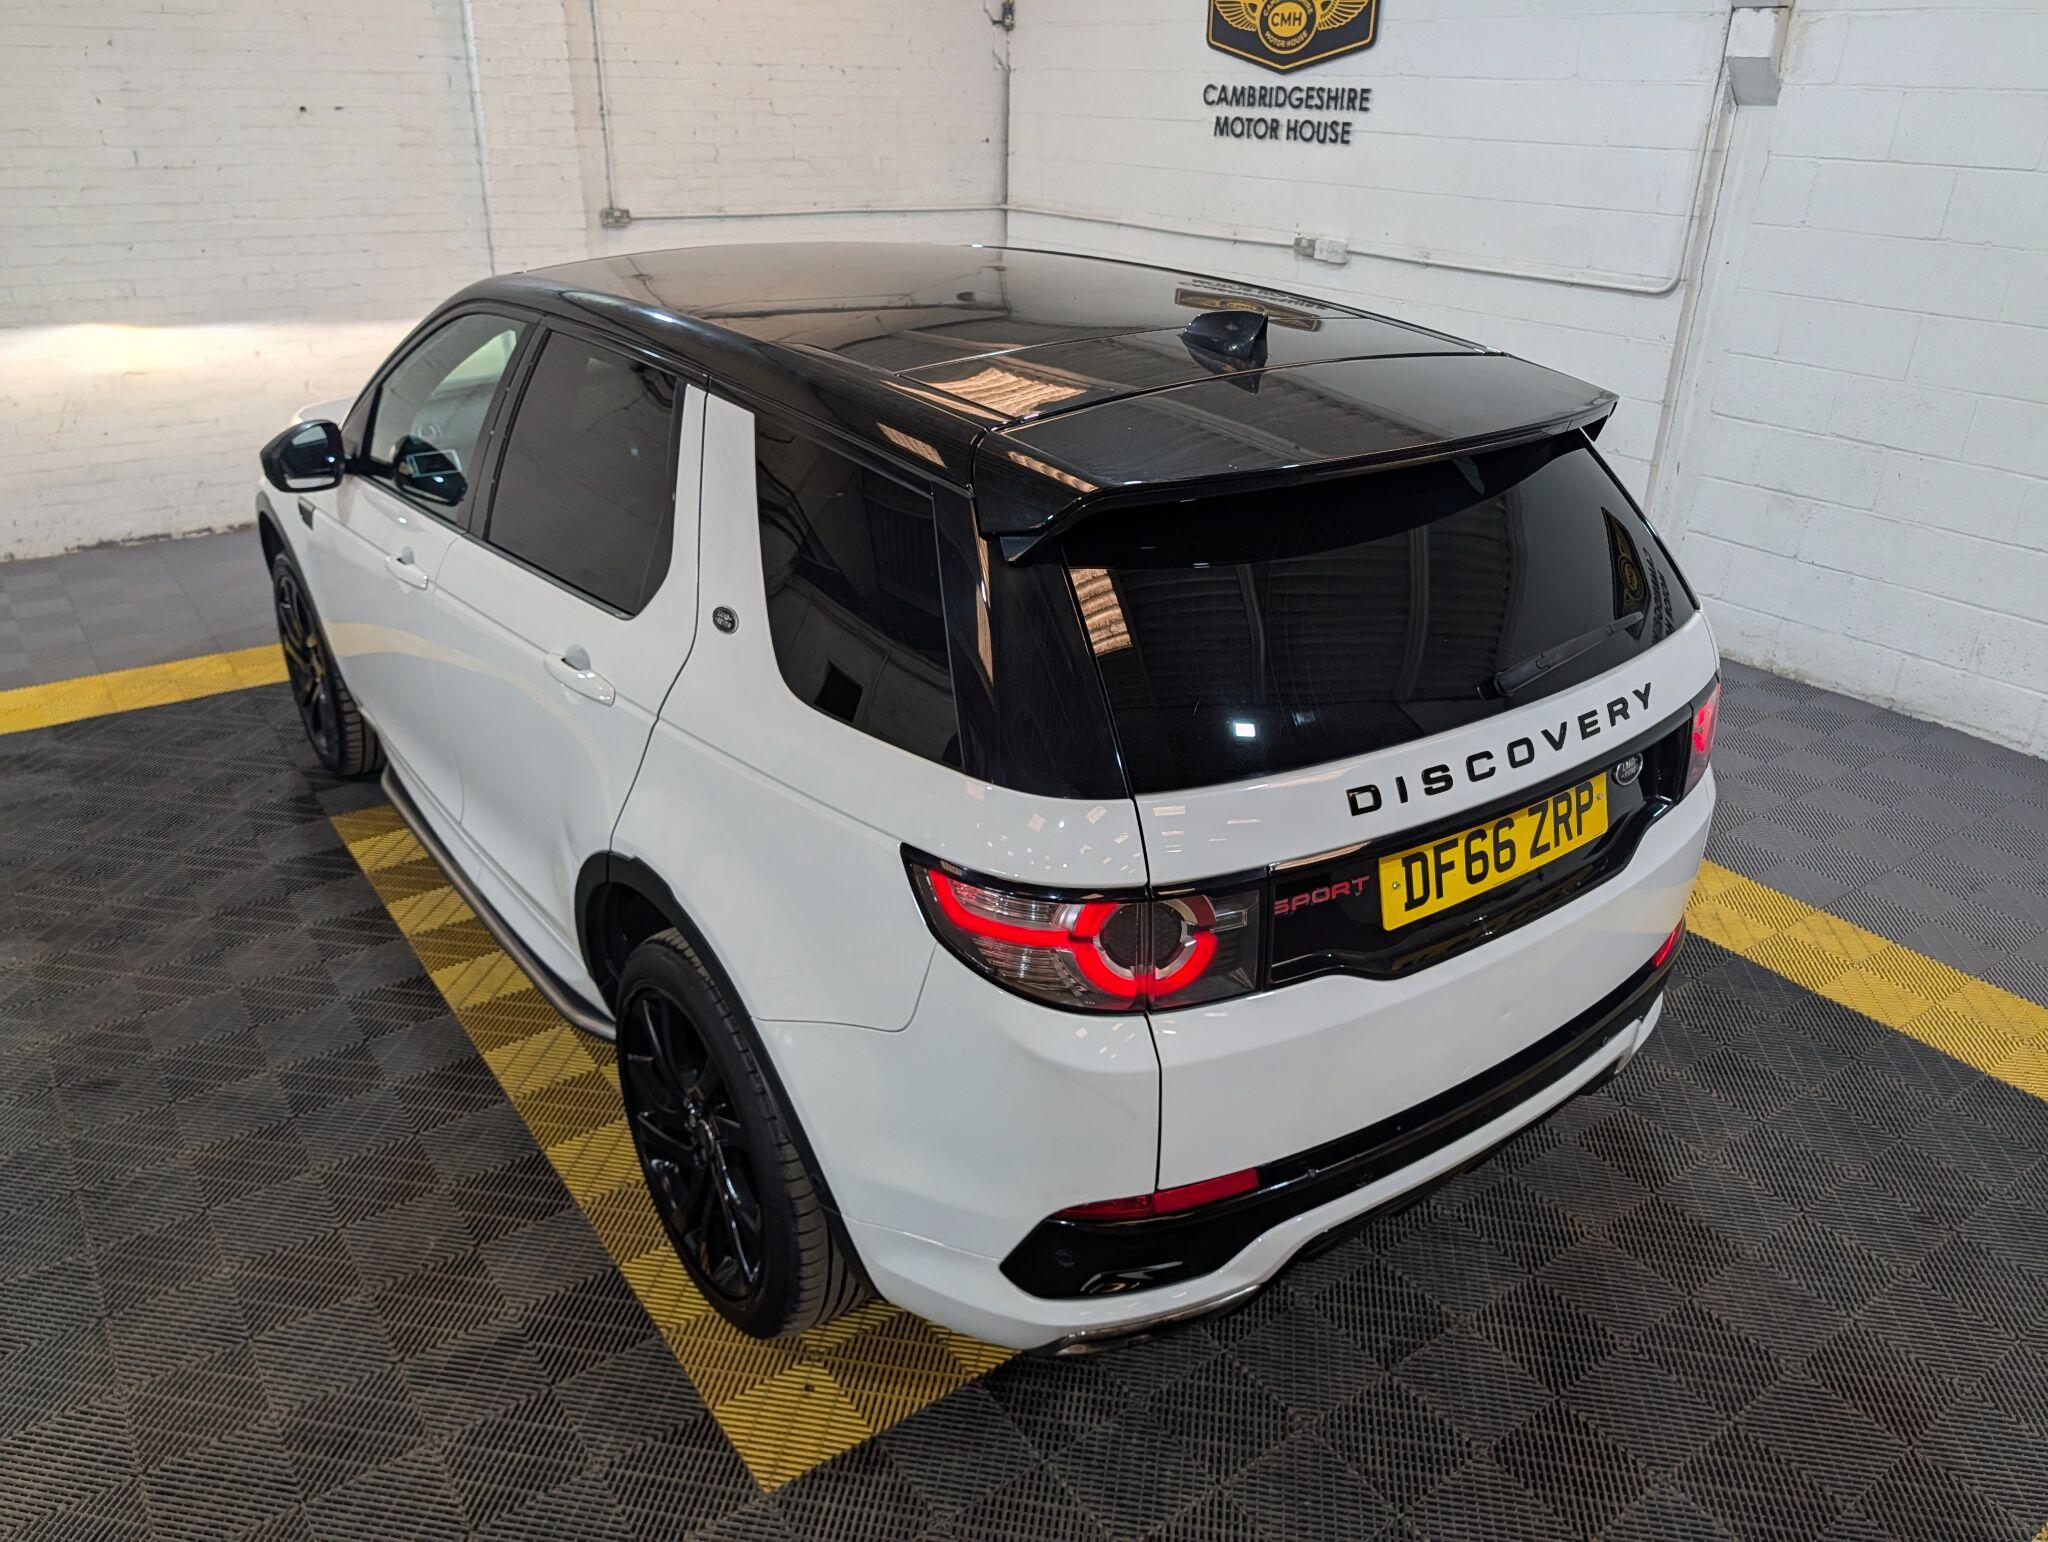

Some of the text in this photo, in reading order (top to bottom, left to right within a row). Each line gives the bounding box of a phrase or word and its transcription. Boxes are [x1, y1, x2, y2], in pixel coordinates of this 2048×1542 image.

[1271, 12, 1302, 27] CMH
[1203, 84, 1372, 112] CAMBRIDGESHIRE
[1213, 116, 1352, 145] MOTOR HOUSE
[1346, 682, 1651, 816] DISCOVERY
[1401, 781, 1594, 912] DF66 ZRP
[1274, 875, 1370, 915] SPORT
